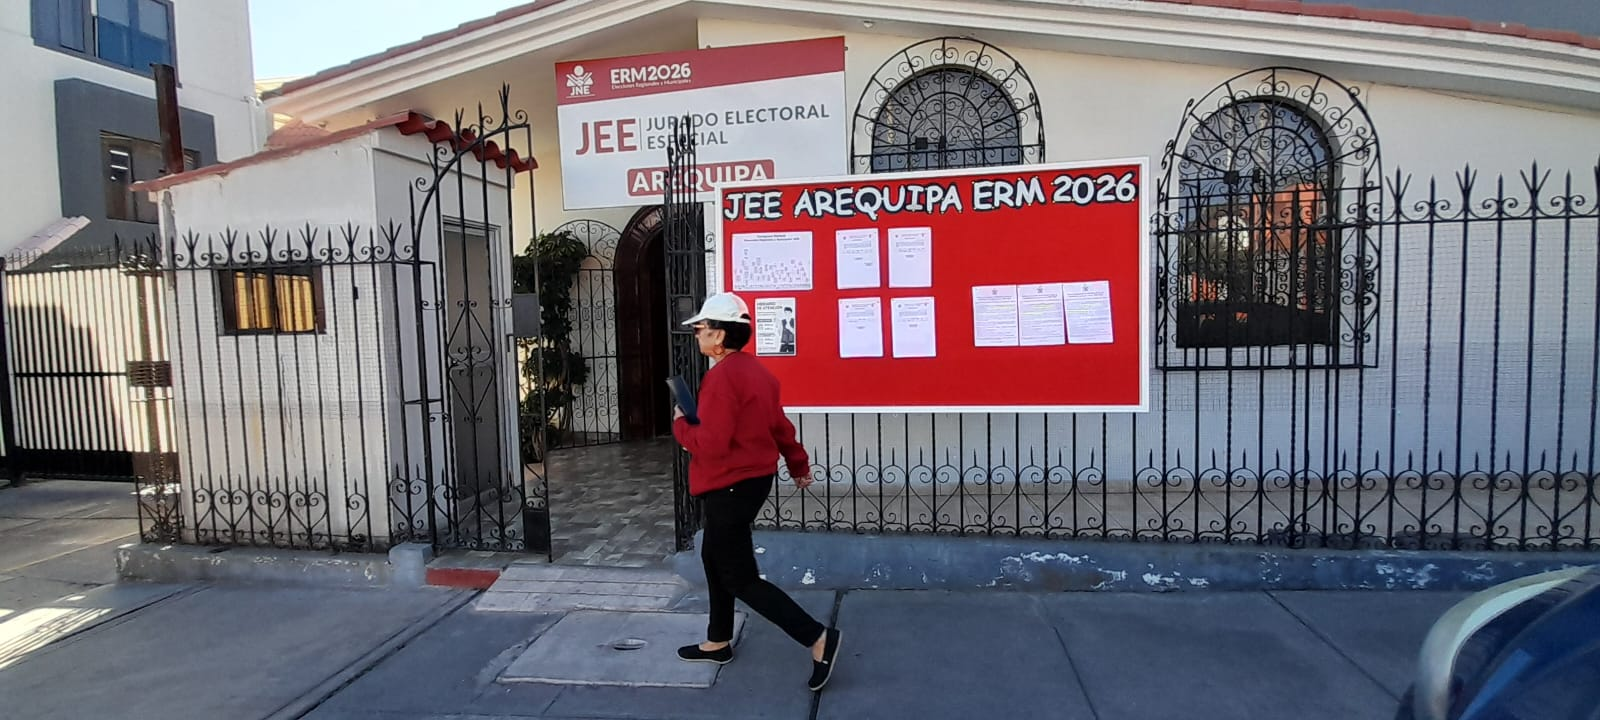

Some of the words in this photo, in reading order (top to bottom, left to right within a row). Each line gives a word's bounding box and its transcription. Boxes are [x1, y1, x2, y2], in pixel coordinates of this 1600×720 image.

[610, 63, 692, 84] ERM2026
[570, 85, 591, 96] JNE
[646, 113, 718, 131] JURADO
[725, 104, 830, 125] ELECTORAL
[576, 118, 638, 155] JEE
[723, 191, 784, 221] JEE
[794, 185, 963, 220] AREQUIPA
[973, 175, 1045, 211] ERM
[1053, 173, 1138, 203] 2026
